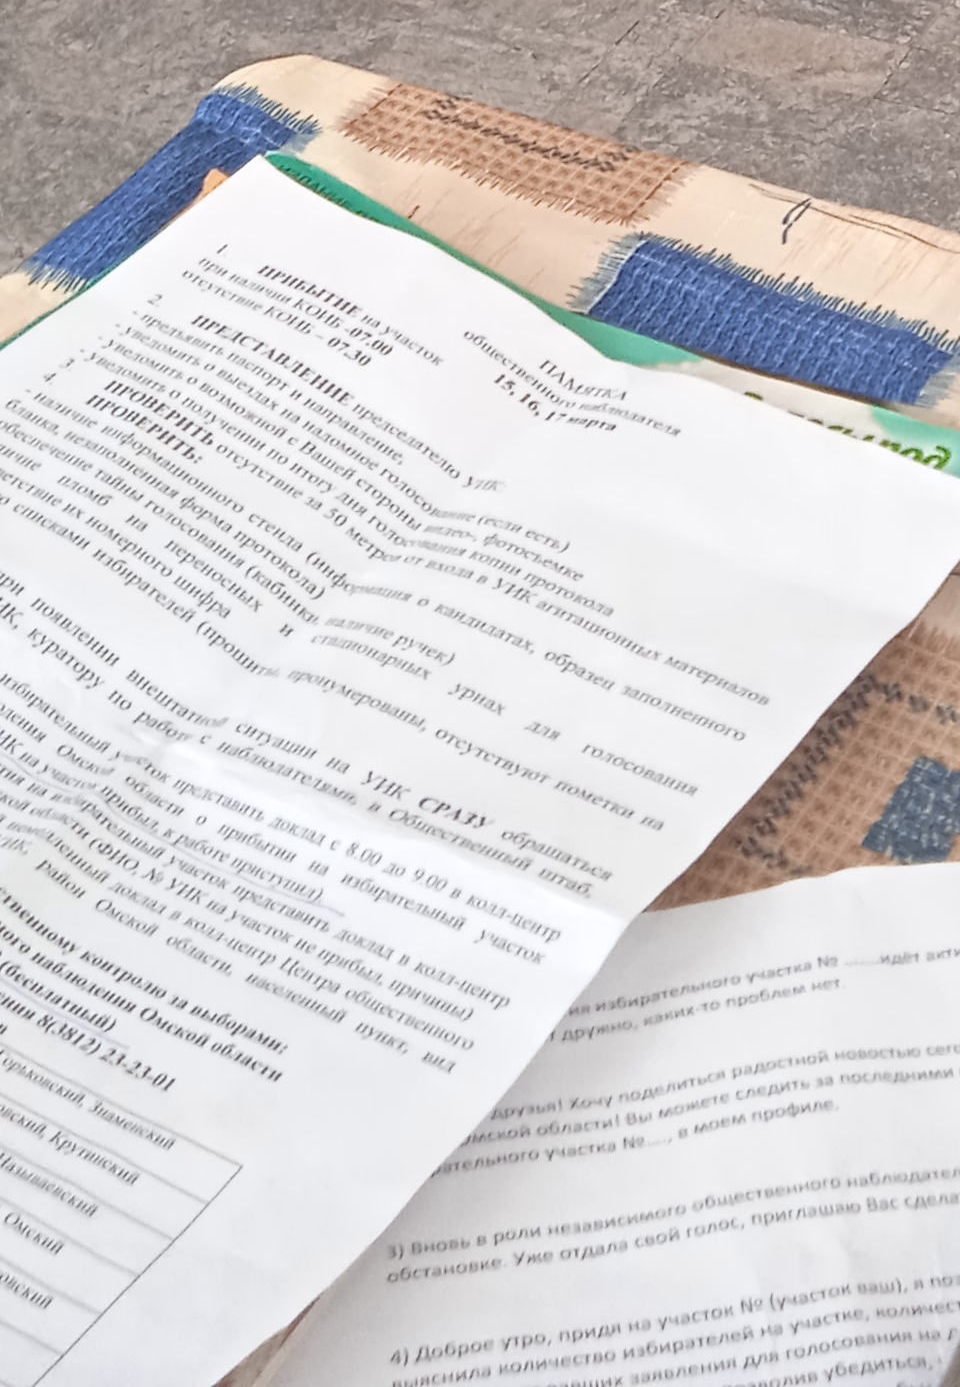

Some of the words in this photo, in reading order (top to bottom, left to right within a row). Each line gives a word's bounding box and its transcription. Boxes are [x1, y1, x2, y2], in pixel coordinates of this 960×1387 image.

[181, 269, 264, 312] отсутствие
[262, 305, 316, 335] КОИБ
[326, 336, 373, 367] 07.30
[198, 257, 229, 278] при
[227, 273, 293, 305] наличии
[291, 297, 345, 329] КОИБ
[256, 264, 363, 318] ПРИБЫТИЕ
[359, 314, 382, 329] на
[378, 325, 444, 367] участок
[124, 326, 201, 367] уведомить
[215, 368, 280, 412] выездах
[278, 407, 302, 425] на
[301, 420, 380, 471] надомное
[190, 314, 355, 407] ПРЕДСТАВЛЕНИЕ
[351, 403, 461, 480] председателю
[225, 351, 291, 392] паспорт
[302, 397, 404, 466] направление,
[462, 330, 577, 409] общественного
[493, 373, 517, 397] 15,
[518, 392, 541, 418] 16,
[543, 410, 567, 422] 17
[565, 412, 618, 432] марта
[538, 359, 628, 401] ПАМЯТКА
[84, 394, 204, 465] ПРОВЕРИТЬ:
[101, 338, 184, 380] уведомить
[198, 381, 289, 439] возможной
[297, 439, 358, 481] Вашей
[355, 477, 423, 532] стороны
[63, 430, 180, 500] незаполненная
[178, 495, 234, 534] форма
[232, 529, 326, 601] протокола)
[83, 351, 167, 393] уведомить
[180, 396, 267, 452] получении
[265, 447, 290, 465] по
[288, 462, 337, 494] итогу
[334, 491, 369, 518] дня
[468, 550, 523, 577] копии
[522, 572, 615, 618] протокола
[93, 468, 145, 503] тайны
[142, 499, 246, 569] голосования
[99, 425, 245, 514] информационного
[247, 513, 304, 553] стенда
[433, 603, 535, 655] кандидатах,
[543, 651, 616, 692] образец
[621, 685, 747, 742] заполненного
[102, 379, 215, 447] ПРОВЕРИТЬ
[215, 443, 304, 499] отсутствие
[303, 496, 324, 512] за
[322, 507, 349, 528] 50
[491, 576, 539, 605] УИК
[535, 600, 662, 661] агитационных
[663, 655, 770, 706] материалов
[360, 769, 412, 801] УИК
[417, 796, 495, 830] СРАЗУ
[500, 830, 613, 882] обращаться
[387, 808, 534, 872] Общественный
[345, 841, 384, 867] 8.00
[381, 862, 407, 877] до
[412, 868, 449, 892] 9.00
[465, 894, 562, 944] колл-центр
[29, 951, 138, 1014] наблюдения
[138, 1006, 212, 1049] Омской
[209, 1041, 284, 1083] области
[78, 950, 168, 1000] контролю
[167, 994, 189, 1011] за
[188, 1004, 289, 1056] выборами:
[724, 984, 807, 1009] проблем
[36, 1012, 103, 1057] 8(3812)
[100, 1049, 178, 1093] 23-23-01
[568, 1094, 614, 1111] Хочу
[617, 1069, 727, 1104] поделиться
[730, 1049, 830, 1081] радостной
[834, 1046, 922, 1062] новостью
[87, 1099, 177, 1152] Знаменский
[535, 1112, 621, 1138] области!
[624, 1111, 653, 1127] Вы
[657, 1092, 730, 1120] можете
[735, 1079, 811, 1102] следить
[815, 1074, 835, 1089] за
[839, 1067, 955, 1085] последними
[692, 1112, 747, 1135] моем
[49, 1130, 141, 1187] Крутинский
[492, 1225, 542, 1248] роли
[547, 1200, 686, 1236] независимого
[691, 1177, 842, 1213] общественного
[512, 1250, 554, 1267] Уже
[558, 1239, 629, 1262] отдала
[633, 1226, 681, 1250] свой
[685, 1216, 746, 1239] голос,
[750, 1202, 862, 1228] приглашаю
[865, 1196, 899, 1213] Вас
